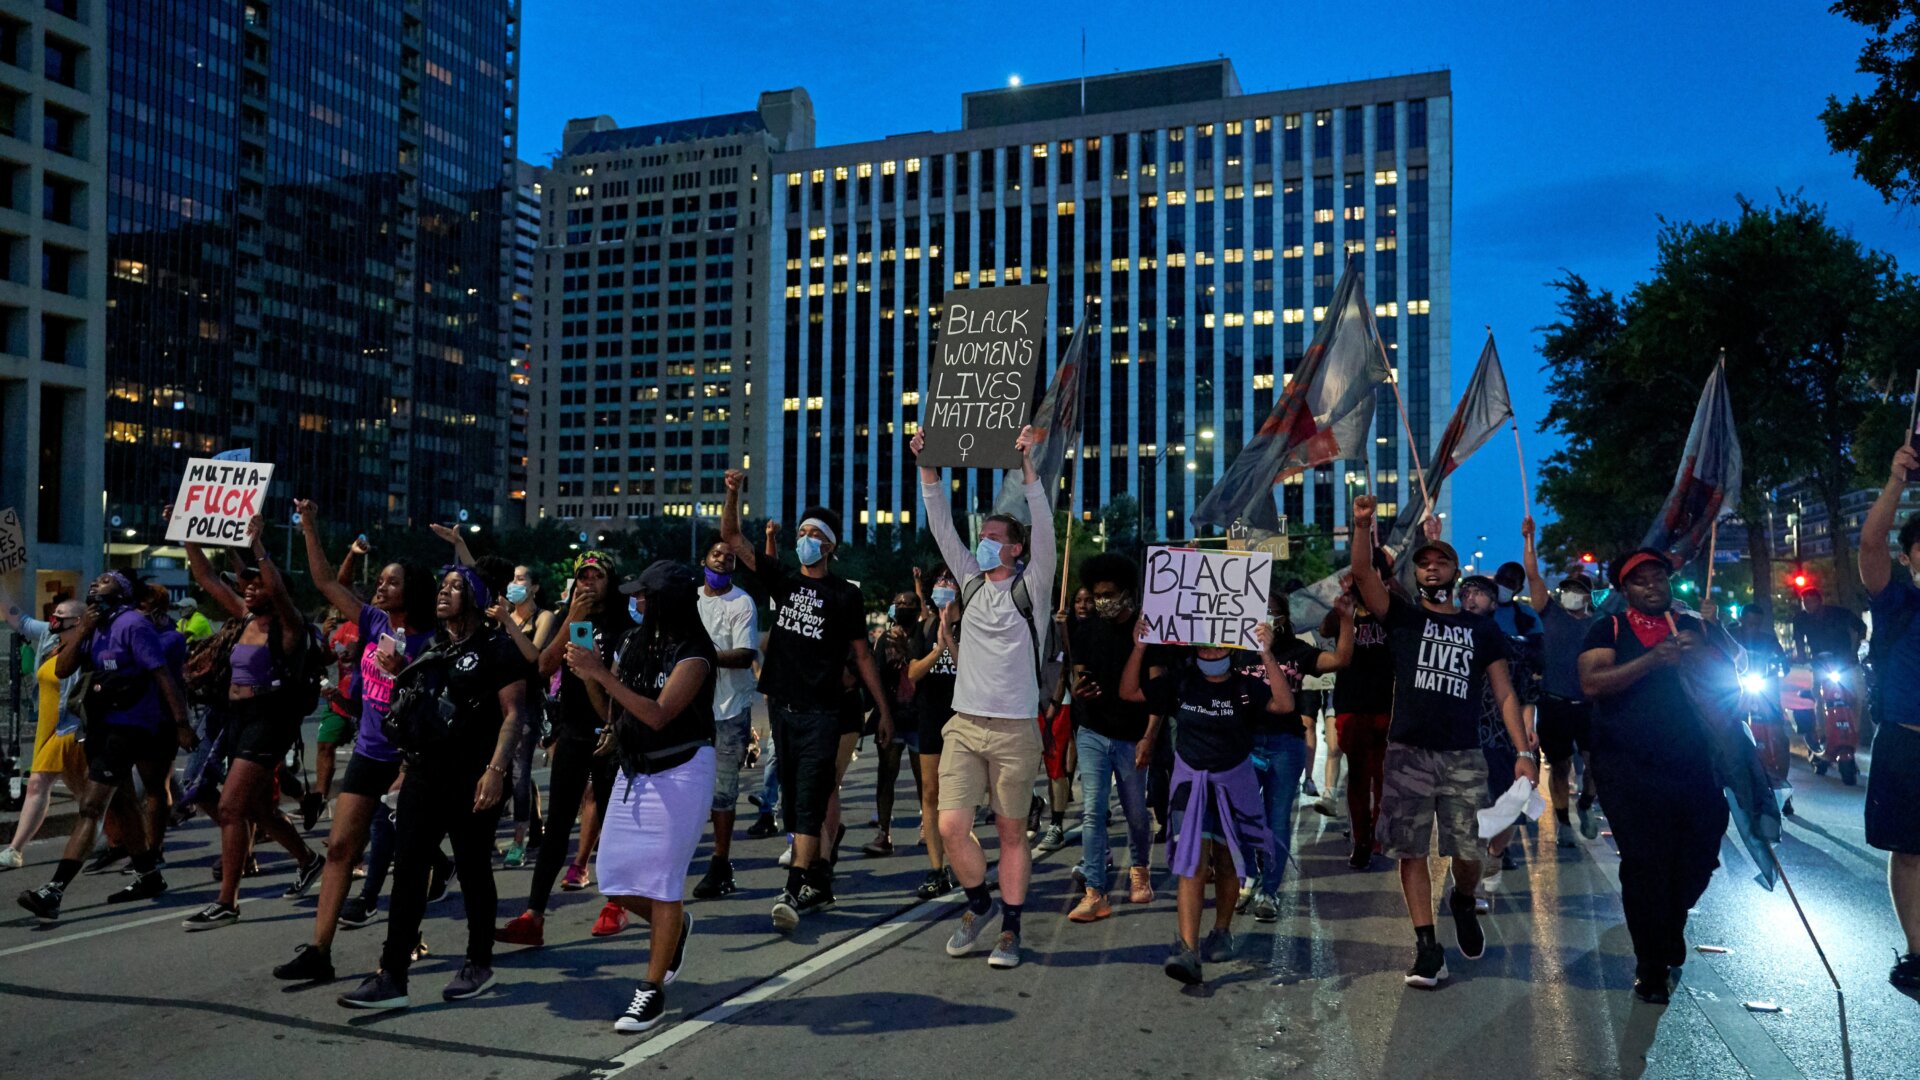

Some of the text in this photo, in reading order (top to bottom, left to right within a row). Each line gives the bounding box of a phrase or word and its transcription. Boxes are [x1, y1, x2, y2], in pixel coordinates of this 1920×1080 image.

[947, 304, 1029, 335] BLACK
[944, 337, 1034, 366] WOMEN'S
[936, 371, 1022, 401] LIVES
[931, 402, 1026, 429] MATTER!
[188, 465, 267, 486] MUTHA-
[184, 485, 258, 519] FUCK
[186, 516, 246, 542] POLICE
[1148, 549, 1270, 603] BLACK
[789, 592, 824, 608] ROOTING
[800, 586, 817, 598] I'M
[1175, 591, 1245, 617] LIVES
[780, 605, 825, 627] EVERYBODY
[793, 602, 813, 614] FOR
[776, 614, 824, 640] BLACK
[1140, 613, 1260, 650] MATTER
[1422, 618, 1474, 648] BLACK
[1417, 641, 1474, 677] LIVES
[1414, 669, 1469, 700] MATTER
